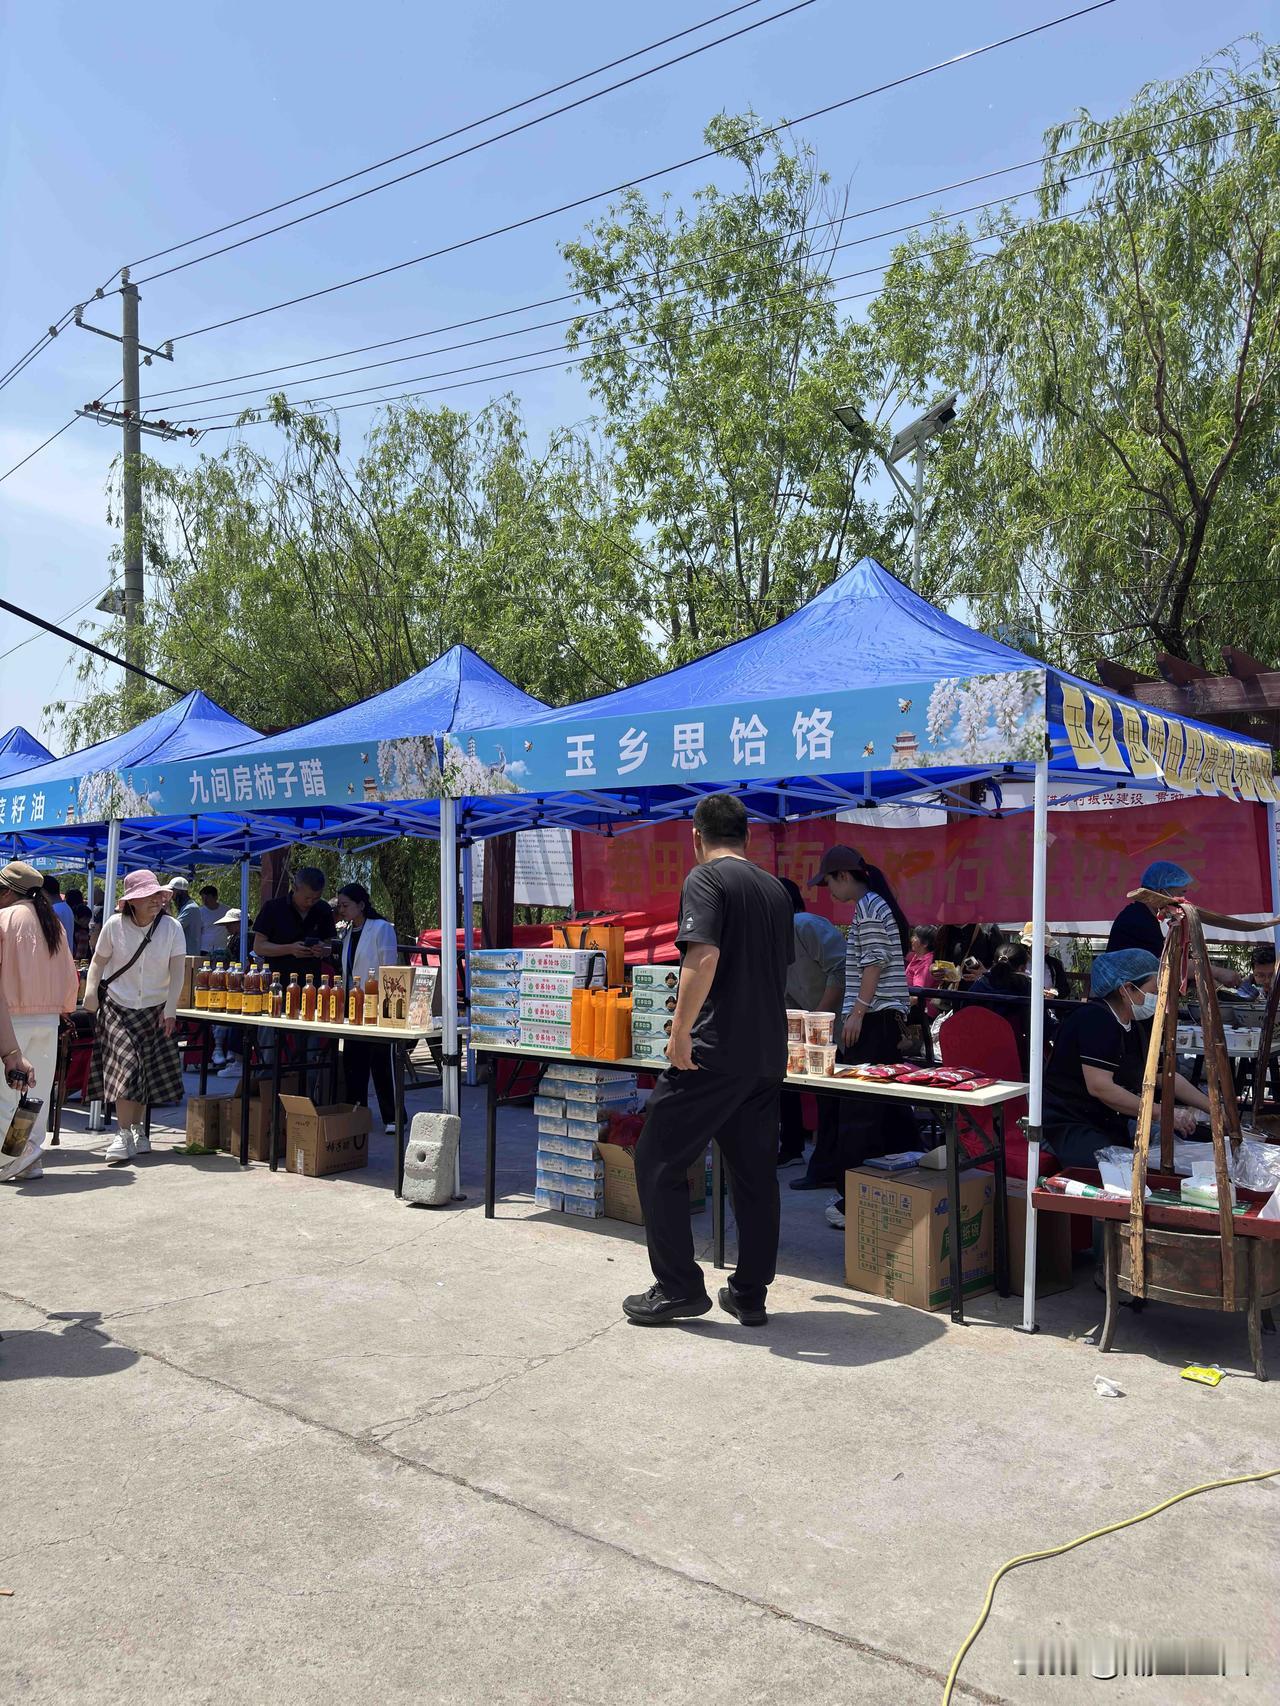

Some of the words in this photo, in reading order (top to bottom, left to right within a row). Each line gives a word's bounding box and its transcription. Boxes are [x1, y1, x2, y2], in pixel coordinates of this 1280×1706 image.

[565, 708, 834, 777] 玉乡思饸饹
[189, 759, 327, 805] 九间房柿子醋
